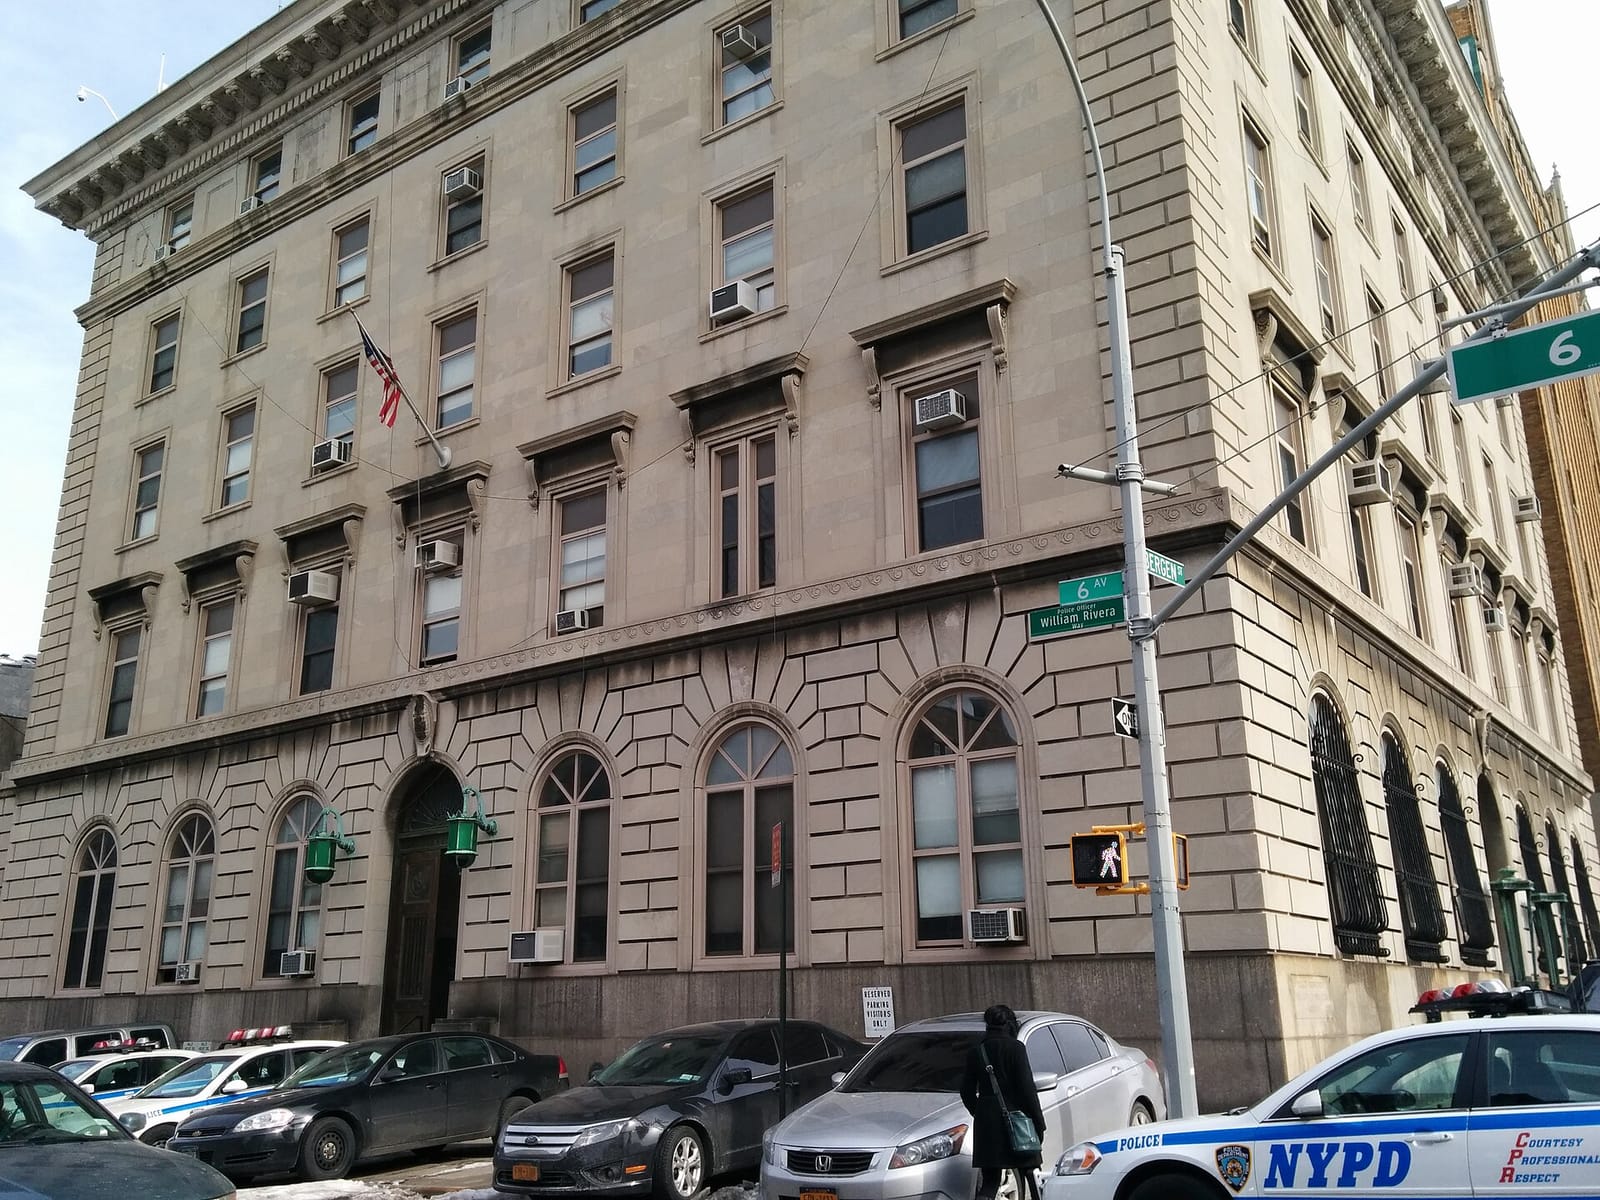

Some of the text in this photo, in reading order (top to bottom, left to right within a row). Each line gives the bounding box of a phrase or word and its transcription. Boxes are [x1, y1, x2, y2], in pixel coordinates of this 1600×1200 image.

[1549, 329, 1582, 366] 6
[1077, 577, 1107, 599] 6 AV
[1057, 602, 1097, 615] Police Officer
[1040, 607, 1116, 628] William Rivera
[864, 990, 891, 998] RESERVED
[1119, 1134, 1160, 1151] POLICE
[1515, 1132, 1584, 1148] COURTESY
[1263, 1141, 1411, 1188] NYPD
[1499, 1167, 1560, 1183] RESPECT
